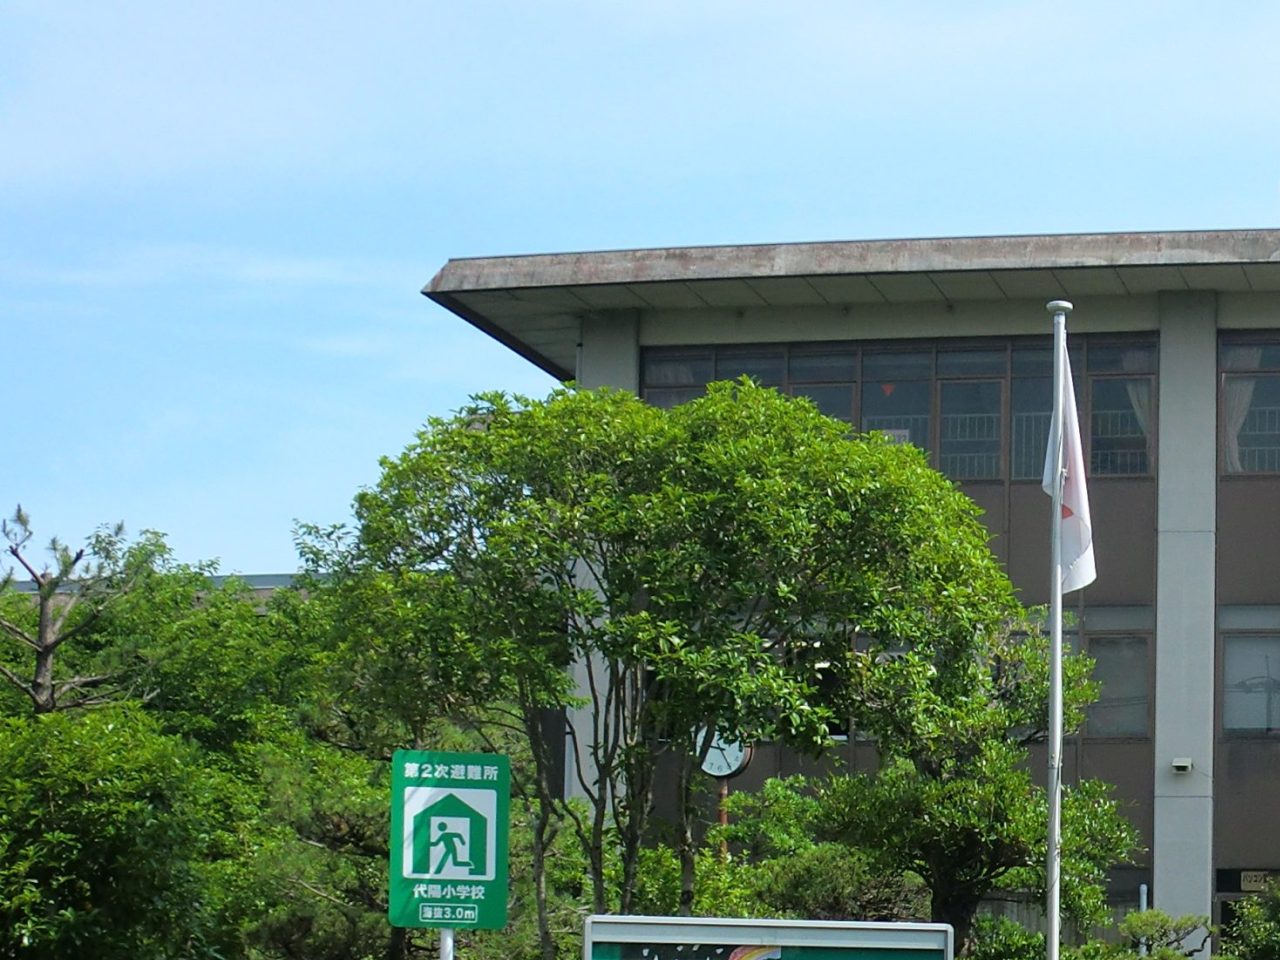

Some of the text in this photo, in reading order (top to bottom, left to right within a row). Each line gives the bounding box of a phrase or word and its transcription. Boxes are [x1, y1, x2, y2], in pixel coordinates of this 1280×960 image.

[404, 762, 499, 781] 第2次避難所
[413, 884, 485, 900] 代陽小学校
[422, 906, 475, 920] 海抜3.0m
